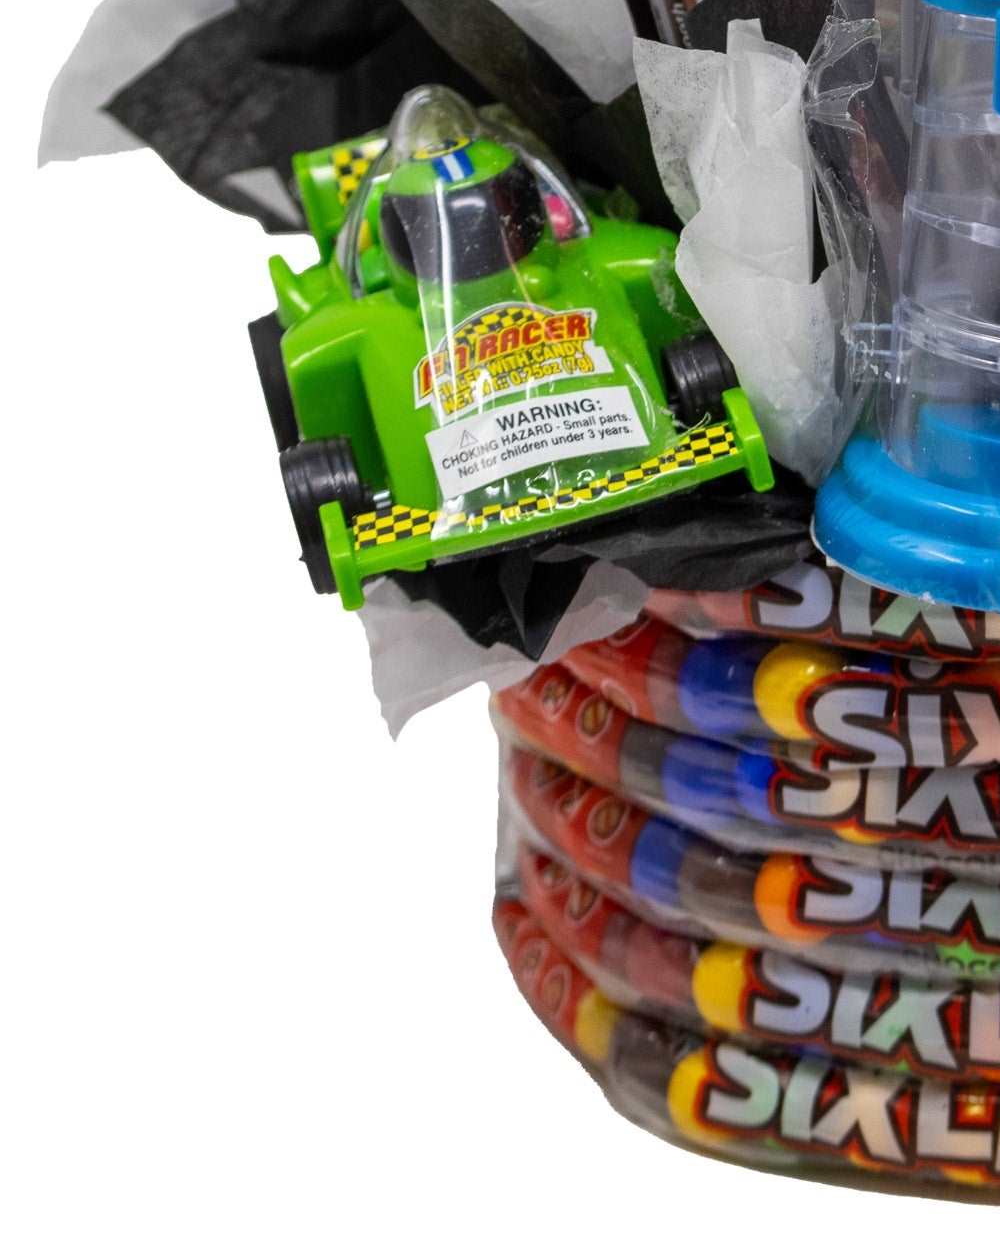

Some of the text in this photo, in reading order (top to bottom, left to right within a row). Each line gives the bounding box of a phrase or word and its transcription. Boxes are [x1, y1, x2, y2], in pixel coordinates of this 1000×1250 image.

[476, 313, 589, 364] RACER
[489, 355, 530, 378] WITH
[530, 340, 586, 362] CANDY
[496, 398, 603, 432] WARNING:
[441, 439, 499, 471] CHOKING
[501, 423, 554, 447] HAZARD
[564, 416, 597, 431] Small
[599, 412, 632, 430] parts.
[458, 425, 633, 479] Not for children under 3 years.
